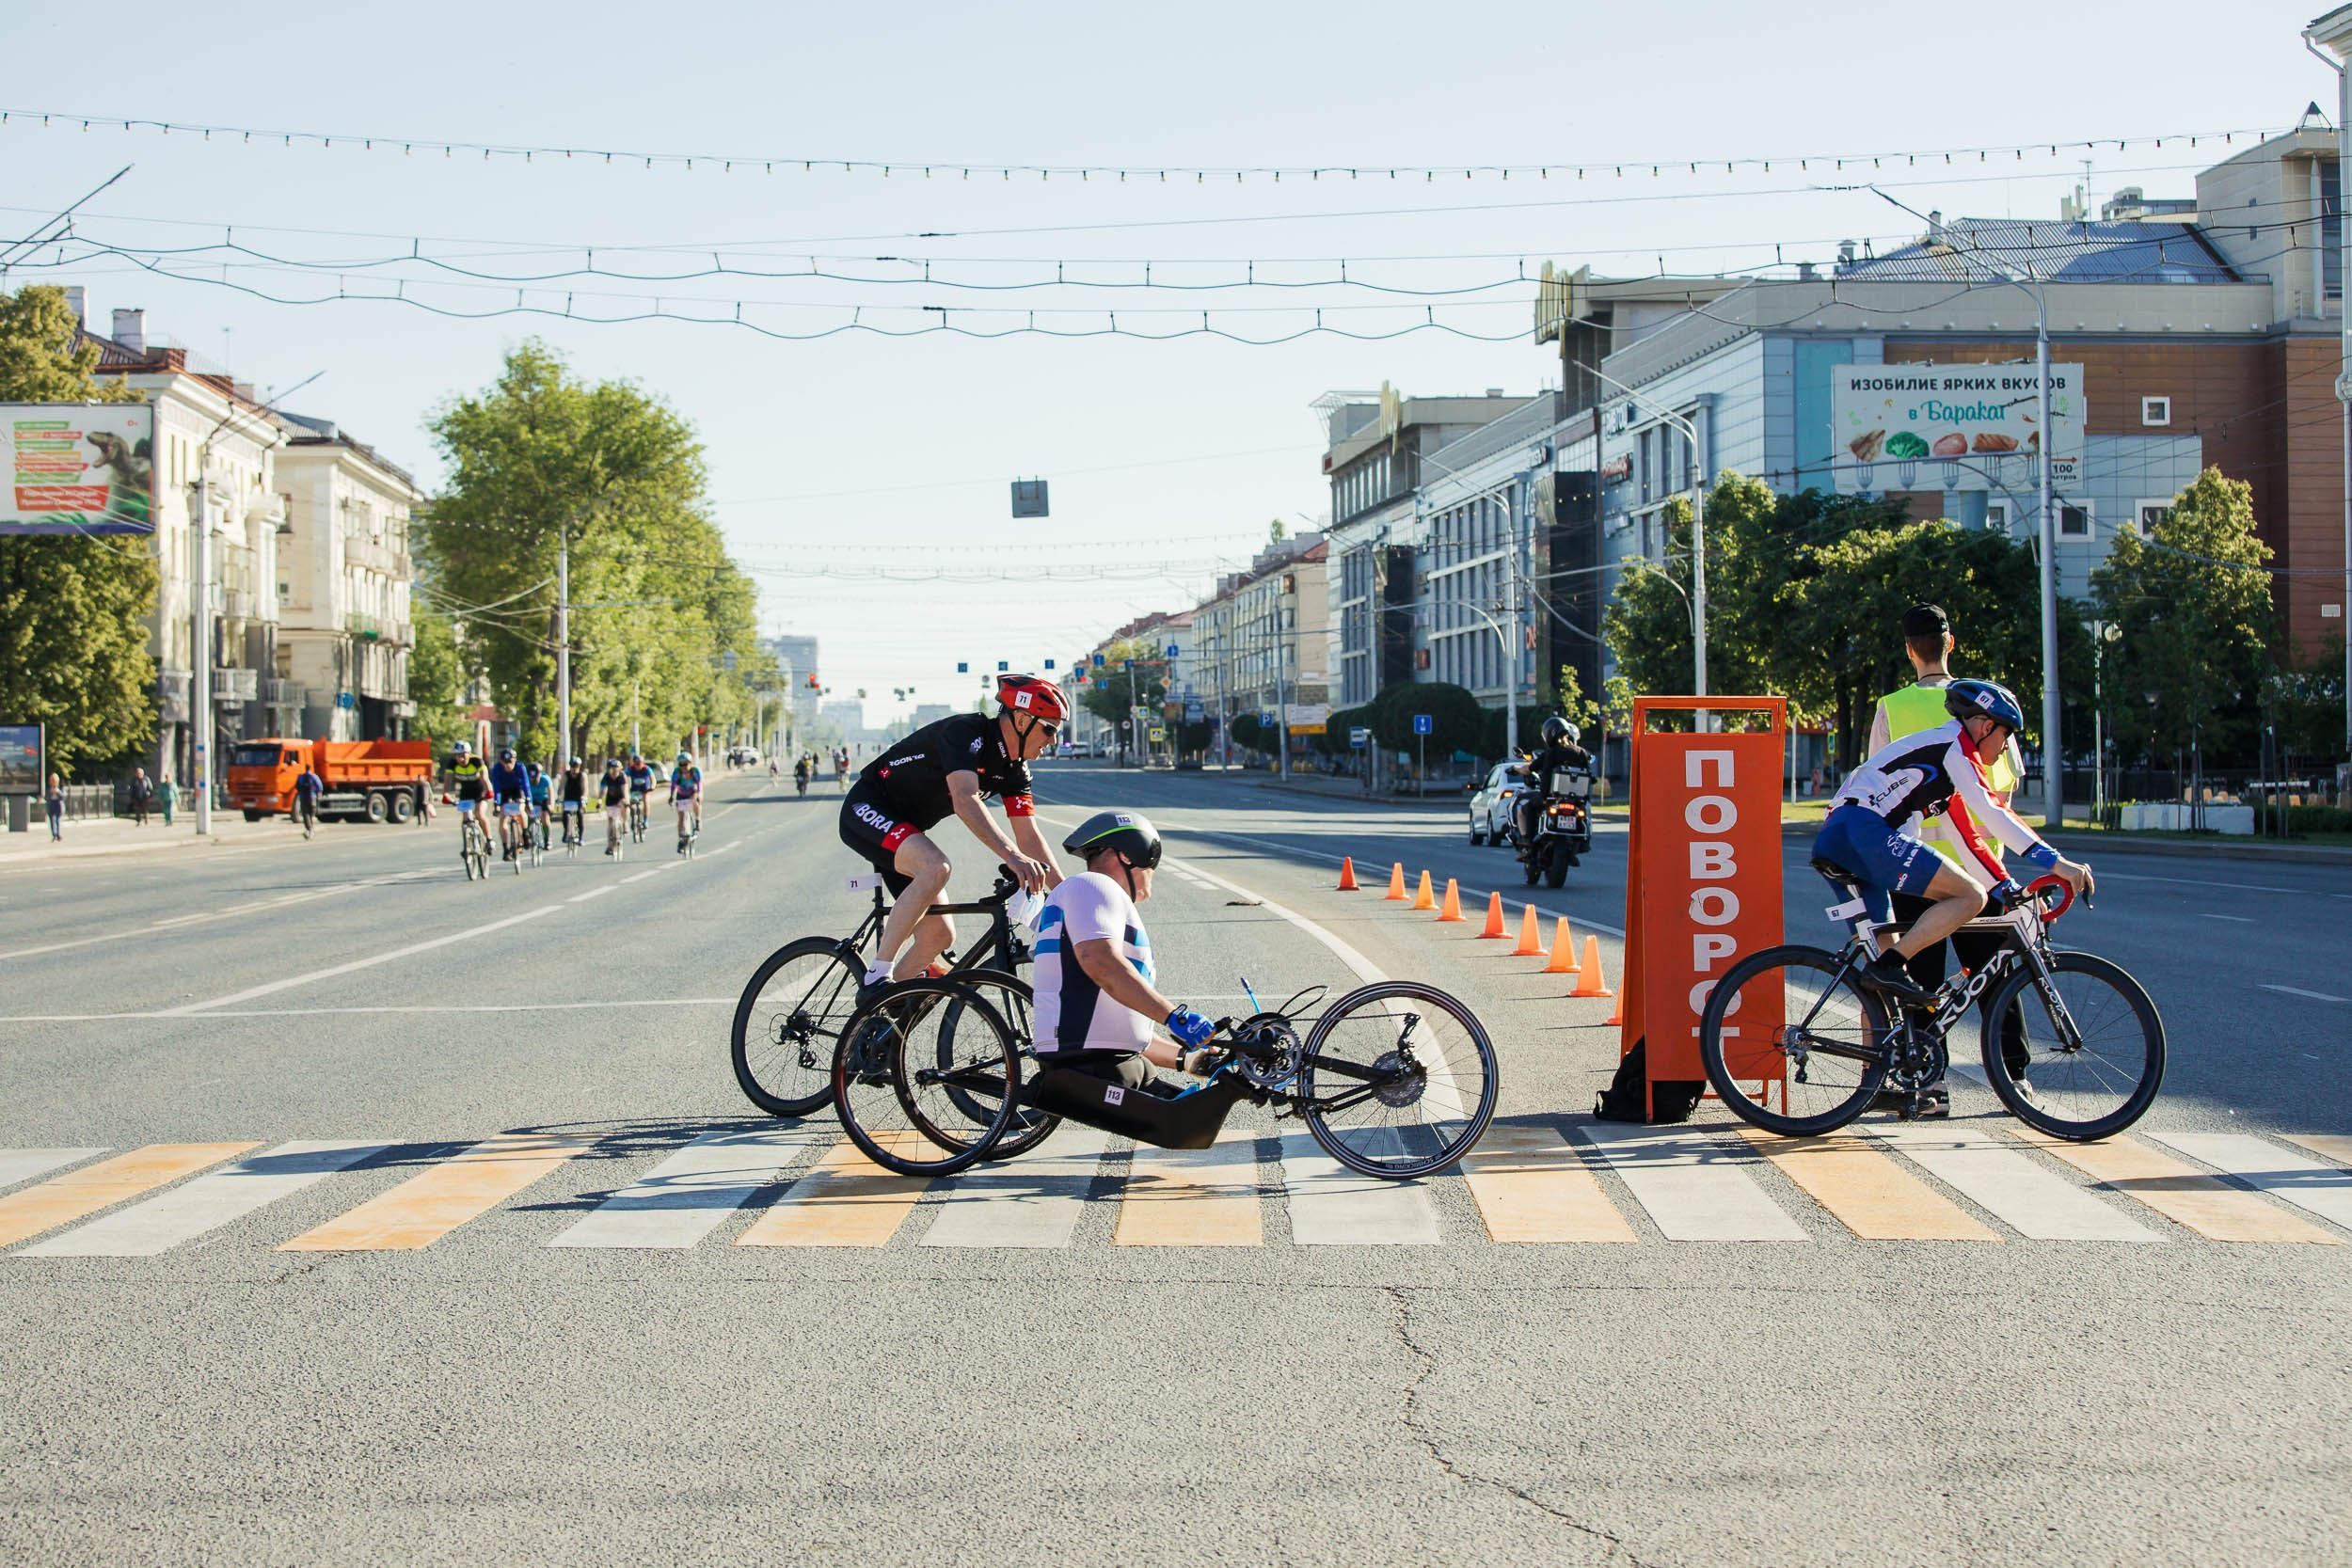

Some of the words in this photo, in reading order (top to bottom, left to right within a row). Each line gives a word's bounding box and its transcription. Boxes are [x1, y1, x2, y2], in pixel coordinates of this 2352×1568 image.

[1851, 378, 1938, 390] ИЗОБИЛИЕ
[1943, 378, 1996, 390] ЯРКИХ
[2052, 464, 2074, 474] 100
[1018, 695, 1028, 705] 71
[1979, 694, 1990, 704] 67
[1875, 776, 1910, 802] CUBE
[854, 801, 894, 833] BORA
[850, 879, 858, 889] 71
[1831, 909, 1840, 918] 67
[1935, 949, 2016, 1035] KUOTA
[2038, 976, 2065, 1018] KUOTA
